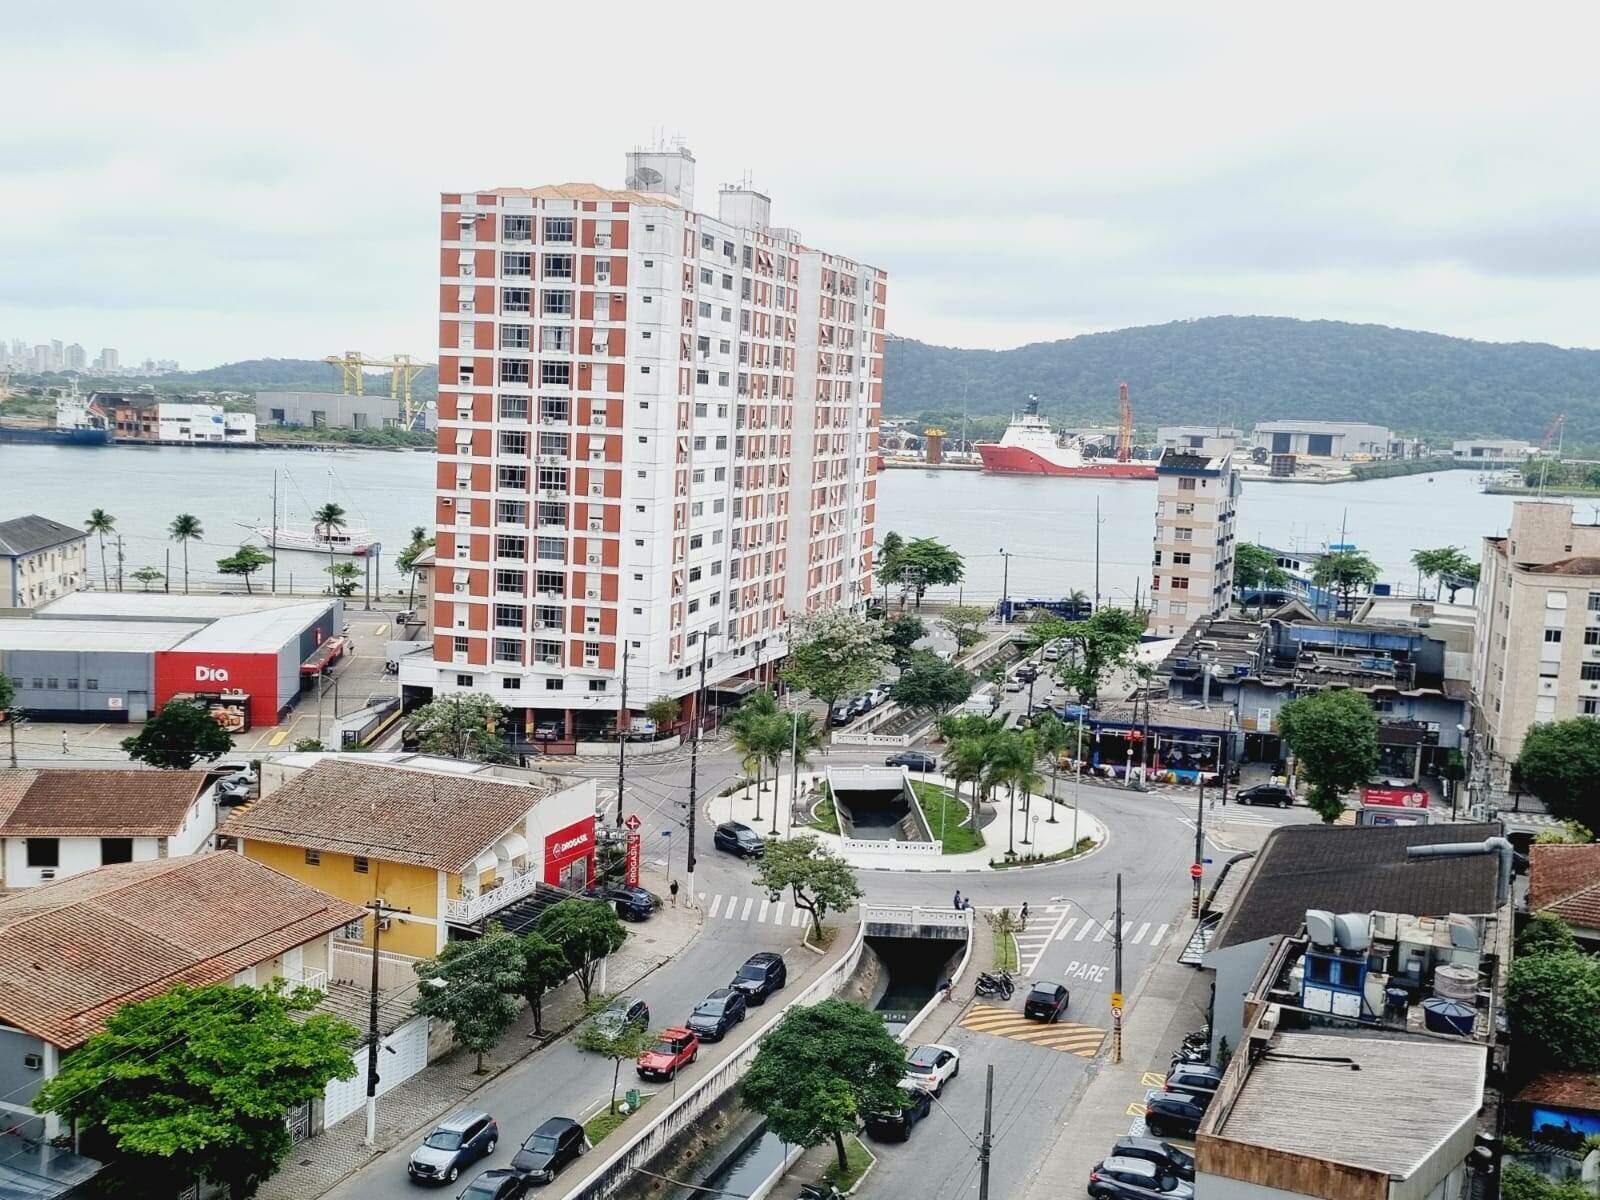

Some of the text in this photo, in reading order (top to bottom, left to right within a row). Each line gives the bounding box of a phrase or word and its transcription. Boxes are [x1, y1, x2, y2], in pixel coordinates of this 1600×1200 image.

[561, 834, 588, 852] DROGASIL
[629, 844, 638, 884] DROGASIL
[1064, 961, 1110, 982] PARE
